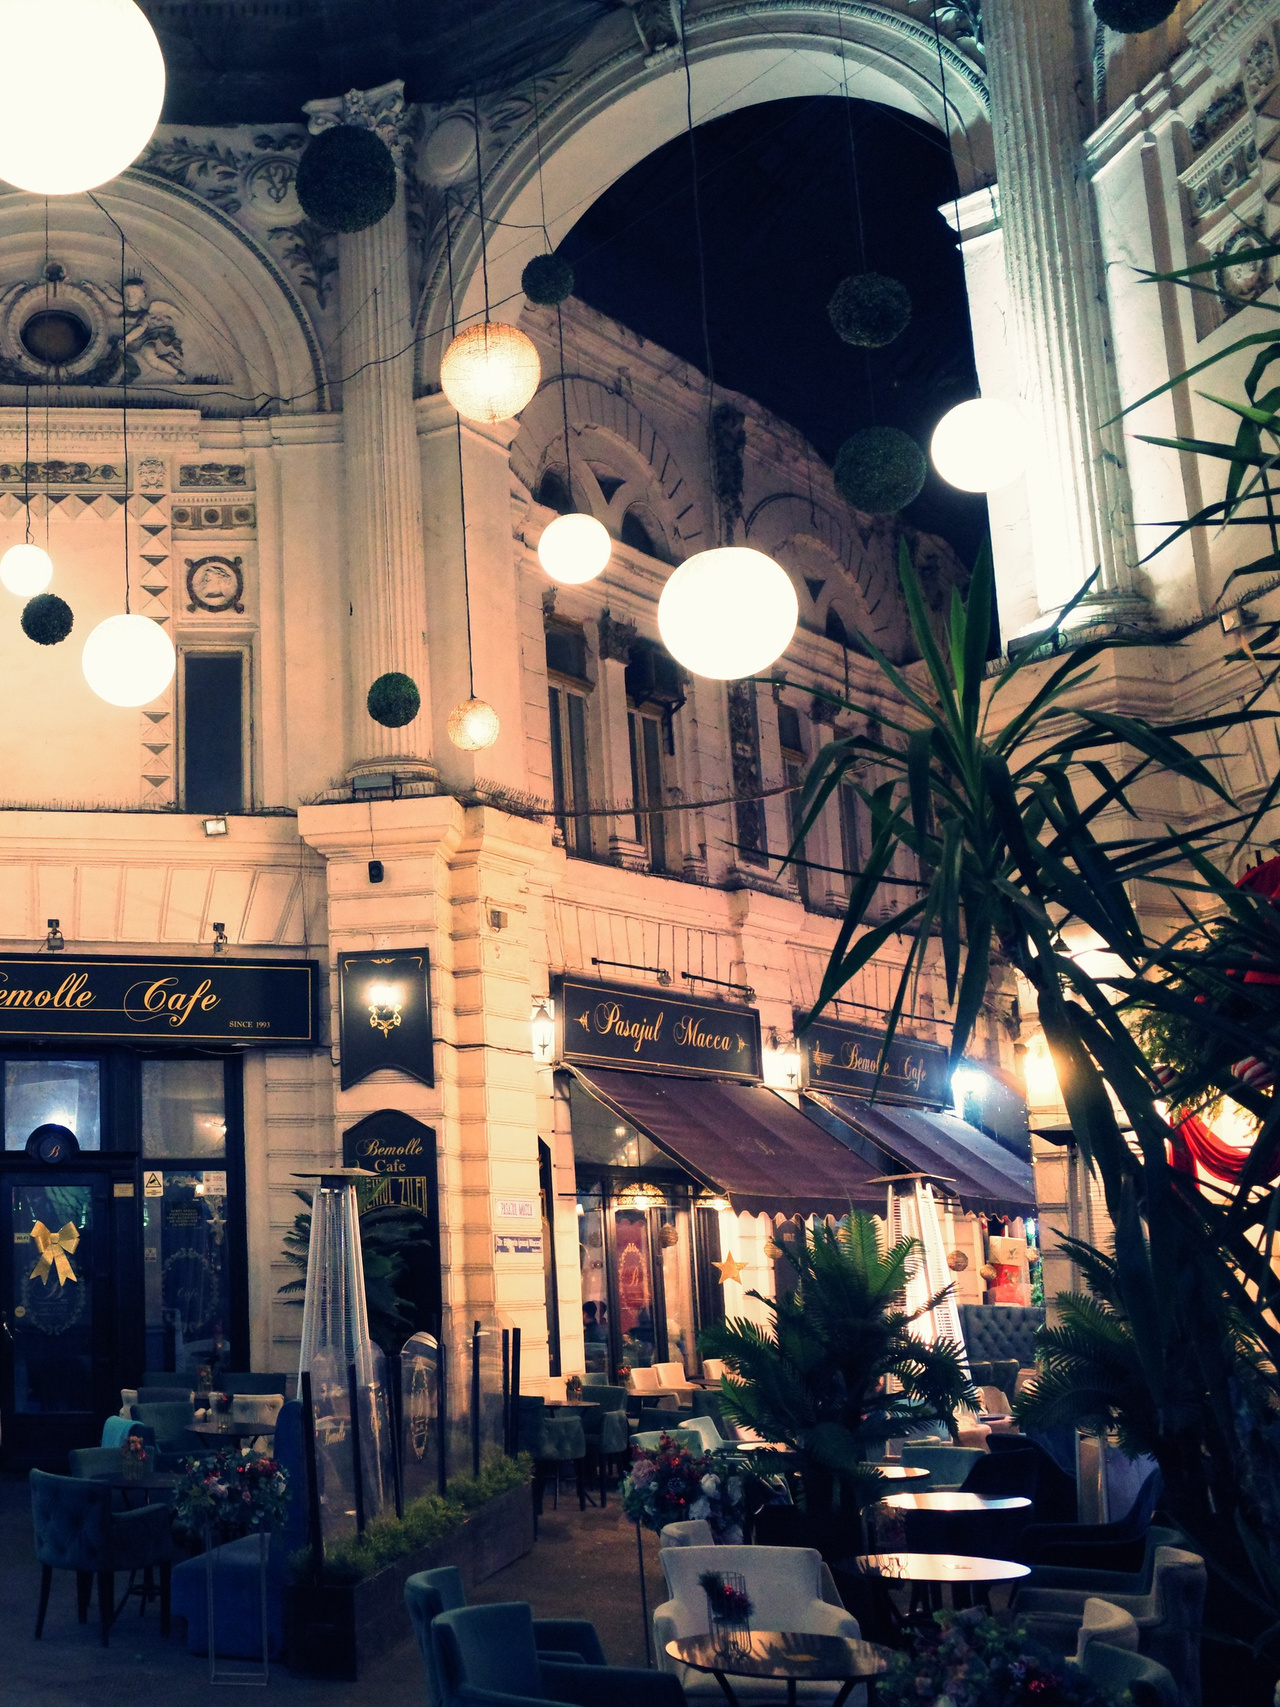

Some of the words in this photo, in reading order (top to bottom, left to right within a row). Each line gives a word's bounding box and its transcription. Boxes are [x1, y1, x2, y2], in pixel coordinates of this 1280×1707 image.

[123, 977, 222, 1027] Cafe
[229, 1021, 253, 1029] SINCE
[256, 1021, 271, 1029] 1993
[594, 1001, 664, 1053] Pasajul
[673, 1014, 733, 1051] Macca
[841, 1041, 890, 1075] Bemole
[900, 1055, 927, 1092] Cafe
[355, 1138, 425, 1157] Bemolle
[374, 1159, 406, 1173] Cafe
